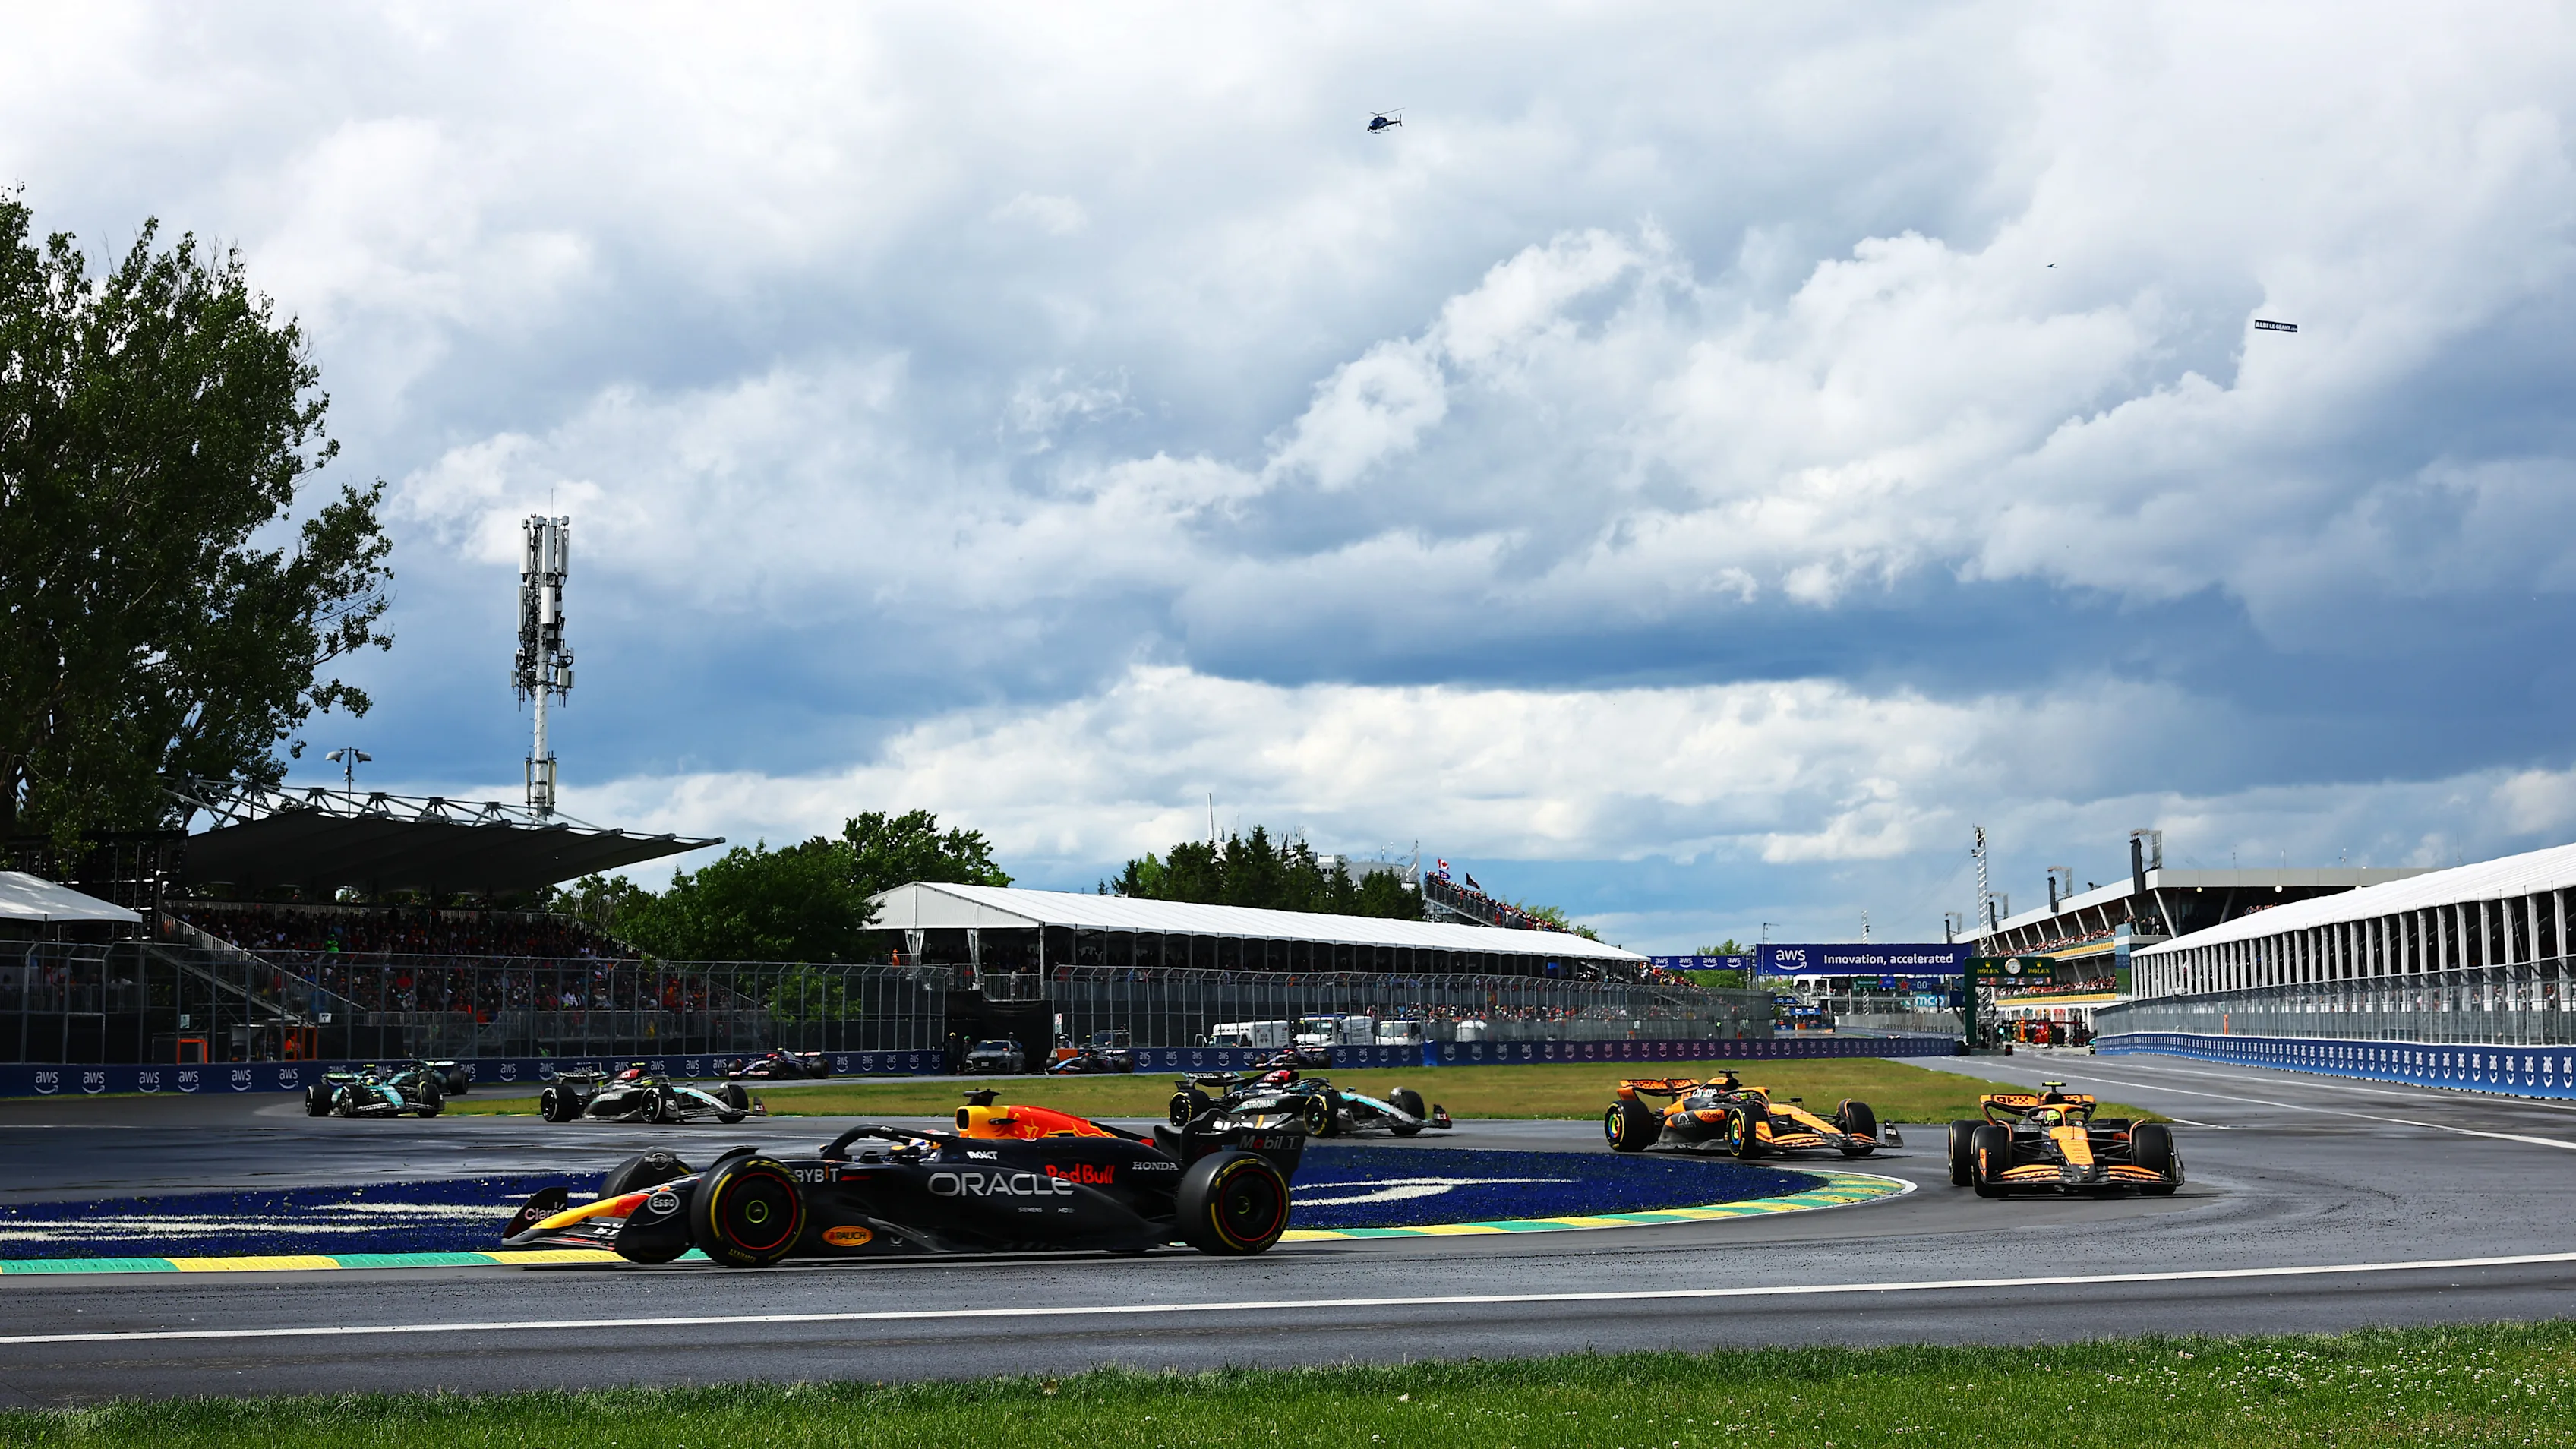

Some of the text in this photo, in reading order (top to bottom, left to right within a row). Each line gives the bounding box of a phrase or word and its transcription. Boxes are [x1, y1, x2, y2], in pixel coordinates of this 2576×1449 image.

[1776, 949, 1806, 961] aws
[1824, 953, 1953, 965] Innovation, accelerated
[1242, 1099, 1276, 1109] PETRONAS
[1239, 1135, 1283, 1150] Mobil
[966, 1151, 998, 1160] ROKT
[1132, 1161, 1179, 1170] HONDA
[794, 1165, 839, 1183] BYBIT
[1045, 1163, 1116, 1184] Red Bull
[927, 1172, 1074, 1197] ORACLE
[652, 1197, 675, 1208] Esso
[525, 1208, 560, 1221] Claro
[836, 1231, 867, 1240] RAUCH
